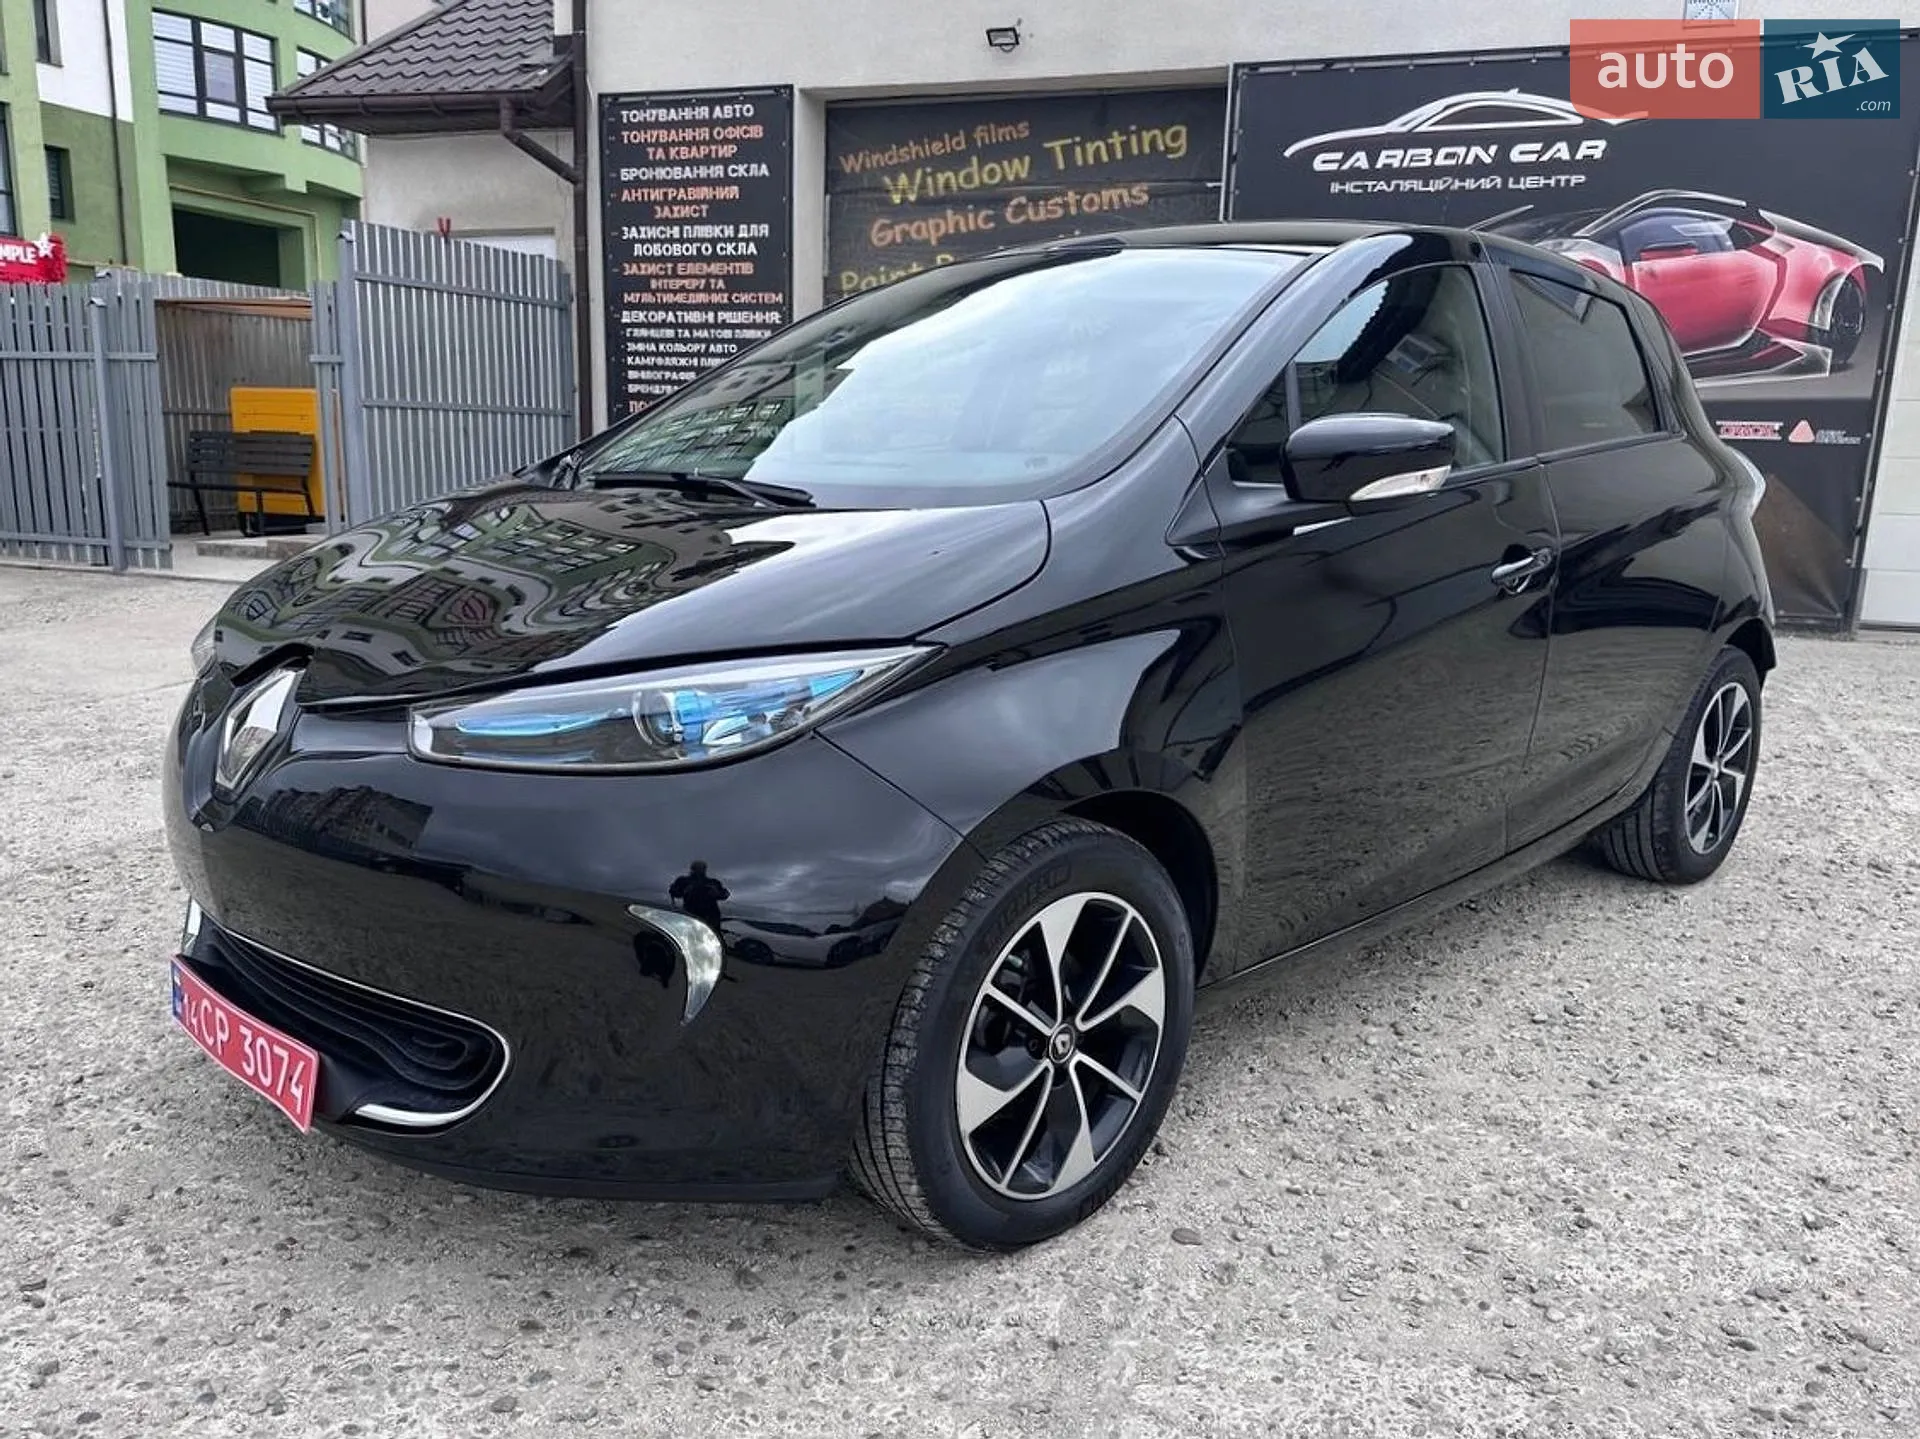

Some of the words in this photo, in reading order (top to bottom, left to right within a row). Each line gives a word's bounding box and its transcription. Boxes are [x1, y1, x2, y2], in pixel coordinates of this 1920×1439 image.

[621, 107, 708, 123] ТОНУВАННЯ
[713, 104, 754, 118] АВТО
[621, 129, 709, 144] ТОНУВАННЯ
[713, 125, 764, 139] ОФІСІВ
[646, 147, 665, 160] ТА
[669, 145, 738, 159] КВАРТИР
[840, 129, 966, 175] Windshield
[973, 120, 1030, 147] films
[1313, 144, 1498, 171] CARBON
[1510, 139, 1607, 164] CAR
[621, 166, 723, 180] БРОНЮВАННЯ
[727, 164, 769, 177] СКЛА
[884, 153, 1031, 205] Window
[1044, 124, 1188, 171] Tinting
[1330, 176, 1501, 194] ІНСТАЛЯЦІЙНИЙ
[1509, 175, 1586, 191] ЦЕНТР
[654, 205, 709, 218] ЗАХИСТ
[870, 207, 995, 248] Graphic
[1004, 183, 1150, 225] Customs
[622, 226, 679, 239] ЗАХИСНІ
[683, 224, 734, 238] ПЛІВКИ
[738, 224, 769, 238] ДЛЯ
[634, 243, 712, 257] ЛОБОВОГО
[716, 242, 758, 255] СКЛА
[623, 263, 673, 275] ЗАХИСТ
[677, 262, 754, 275] ЕЛЕМЕНТІВ
[710, 279, 726, 289] ТА
[732, 292, 783, 304] СИСТЕМ
[621, 312, 714, 323] ДЕКОРАТИВНІ
[678, 329, 690, 338] ТА
[693, 329, 733, 338] МАТОВІ
[627, 343, 655, 353] ЗМІНА
[659, 343, 705, 353] КОЛЬОРУ
[709, 343, 737, 353] АВТО
[239, 1027, 306, 1115] 3074
